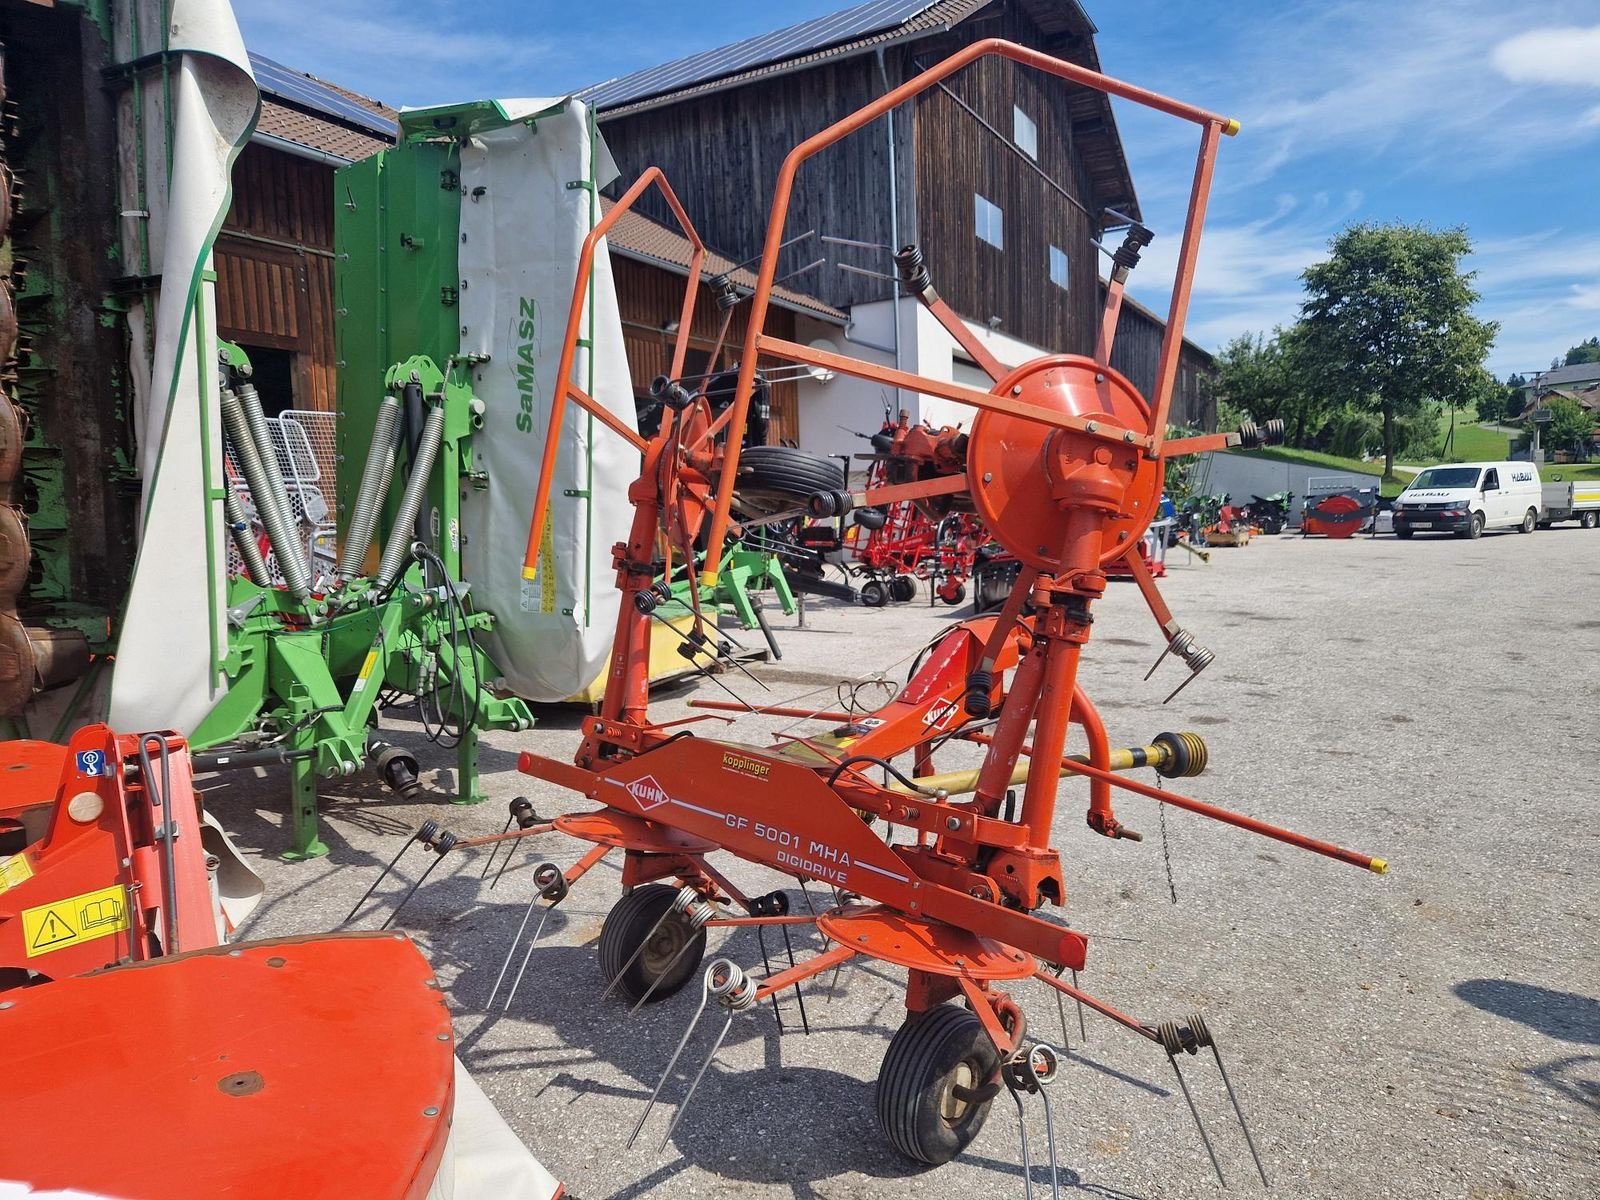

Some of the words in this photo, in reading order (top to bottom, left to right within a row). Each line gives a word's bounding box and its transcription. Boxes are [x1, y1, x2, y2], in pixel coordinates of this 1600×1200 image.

[516, 296, 535, 434] SaMASZ
[631, 782, 664, 803] KUHN
[725, 813, 749, 829] GF
[754, 822, 800, 849] 5001
[809, 841, 850, 867] MHA
[777, 850, 848, 884] DIGIDRIVE
